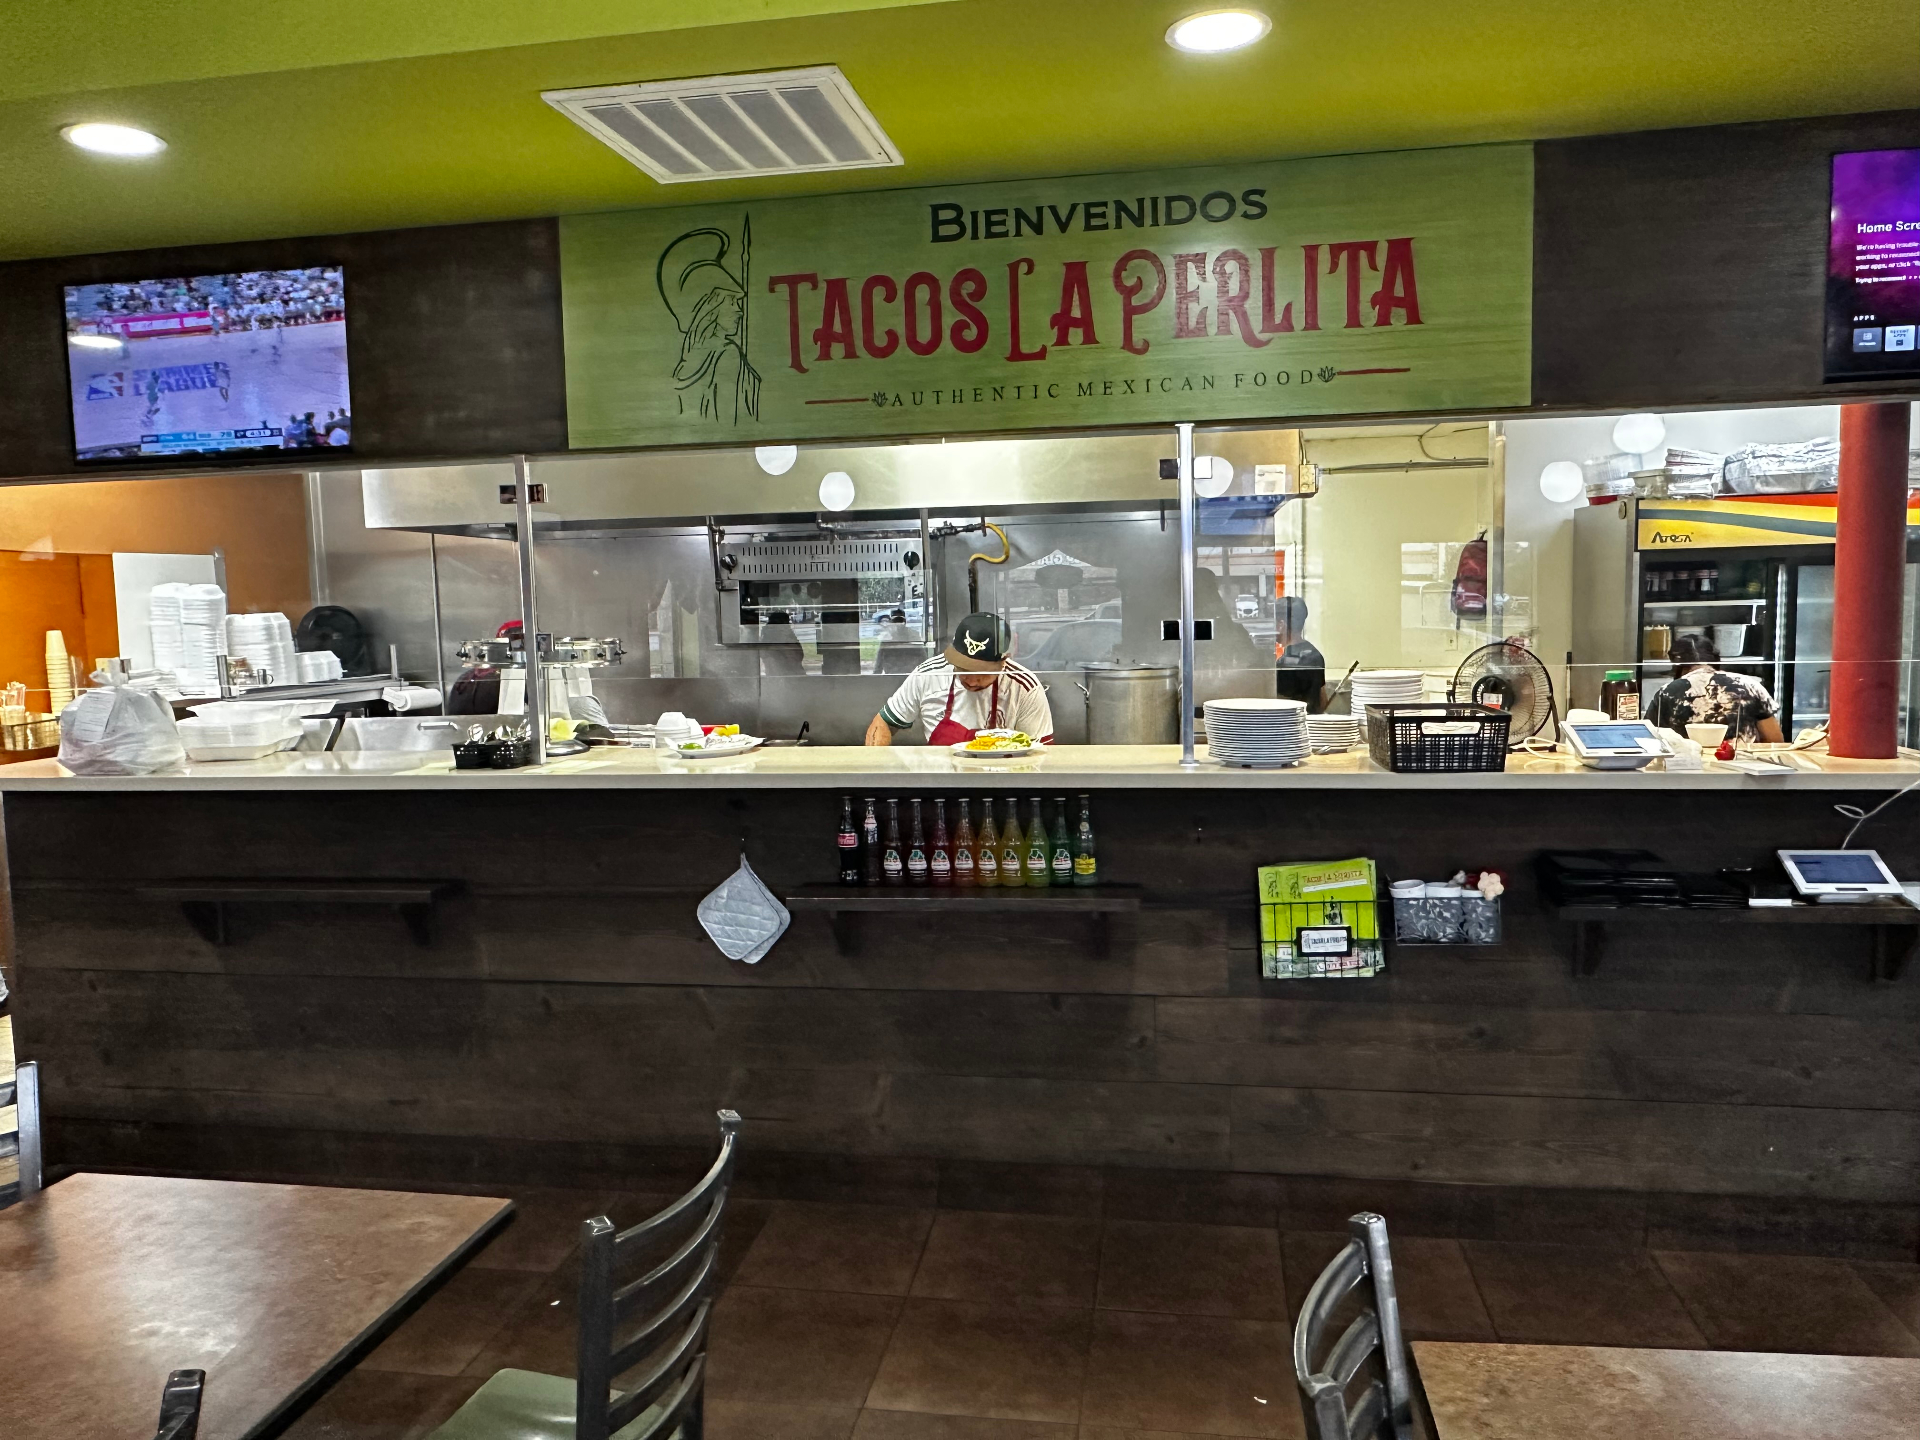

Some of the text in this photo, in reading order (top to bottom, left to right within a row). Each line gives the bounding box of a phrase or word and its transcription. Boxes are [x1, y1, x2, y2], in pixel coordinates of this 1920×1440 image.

[930, 188, 1268, 243] BIENVENIDOS
[1857, 223, 1893, 234] Home
[768, 237, 1425, 374] TACOS LA PERLITA
[891, 369, 1314, 407] AUTHENTIC MEXICAN FOOD
